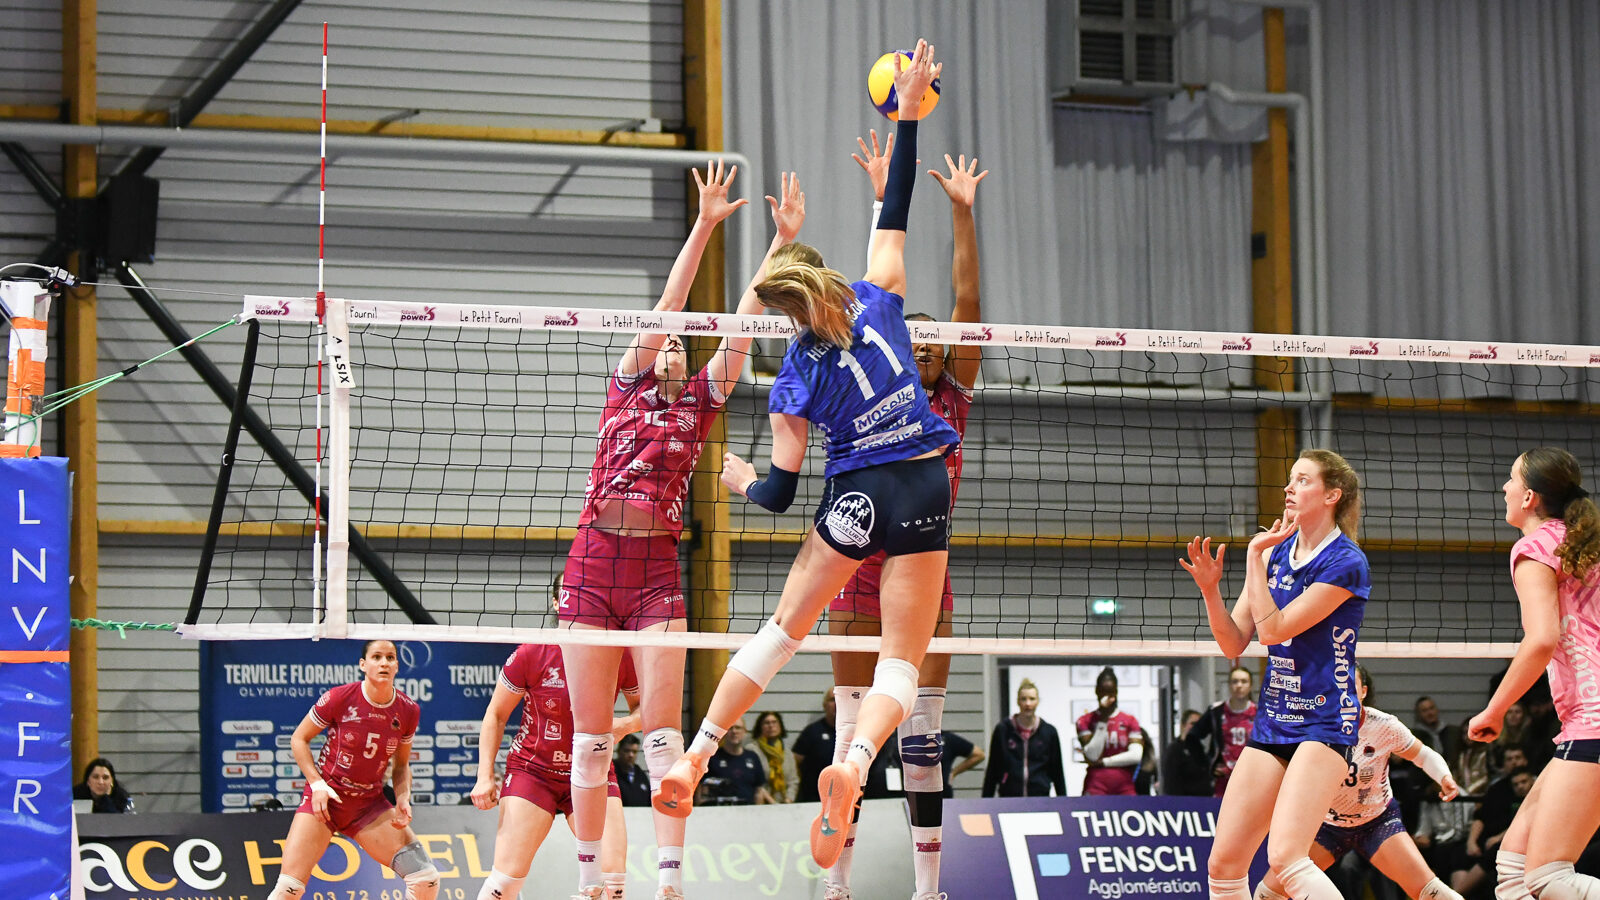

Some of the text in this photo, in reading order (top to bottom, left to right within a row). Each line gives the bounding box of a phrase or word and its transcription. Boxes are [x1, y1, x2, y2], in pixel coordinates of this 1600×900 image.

[350, 306, 378, 319] Fournil
[460, 310, 522, 324] Le Petit Fournil
[602, 315, 663, 329] Le Petit Fournil
[741, 321, 796, 334] Le Petit Fourn
[914, 327, 940, 339] Fournil
[1014, 330, 1071, 344] Le Petit Fournil
[1147, 335, 1203, 349] Le Petit Fournil
[1272, 340, 1326, 353] Le Petit Fournil
[1399, 344, 1451, 358] Le Petit Fournil
[1517, 348, 1525, 360] Le
[1527, 349, 1543, 360] Petit
[837, 325, 904, 401] 11
[857, 390, 913, 429] Moselle
[901, 515, 946, 528] VOLVO
[1271, 660, 1293, 669] oselle
[1560, 613, 1600, 728] Saforell
[224, 664, 362, 685] TERVILLE FLORANGE
[448, 665, 501, 686] TERVIL
[239, 687, 314, 697] OLYMPIQUE
[363, 732, 381, 759] 5
[1071, 810, 1217, 837] THIONVILL
[80, 833, 494, 893] ace HOEL
[1078, 846, 1197, 873] FENSCH
[1087, 877, 1202, 899] Agglomération
